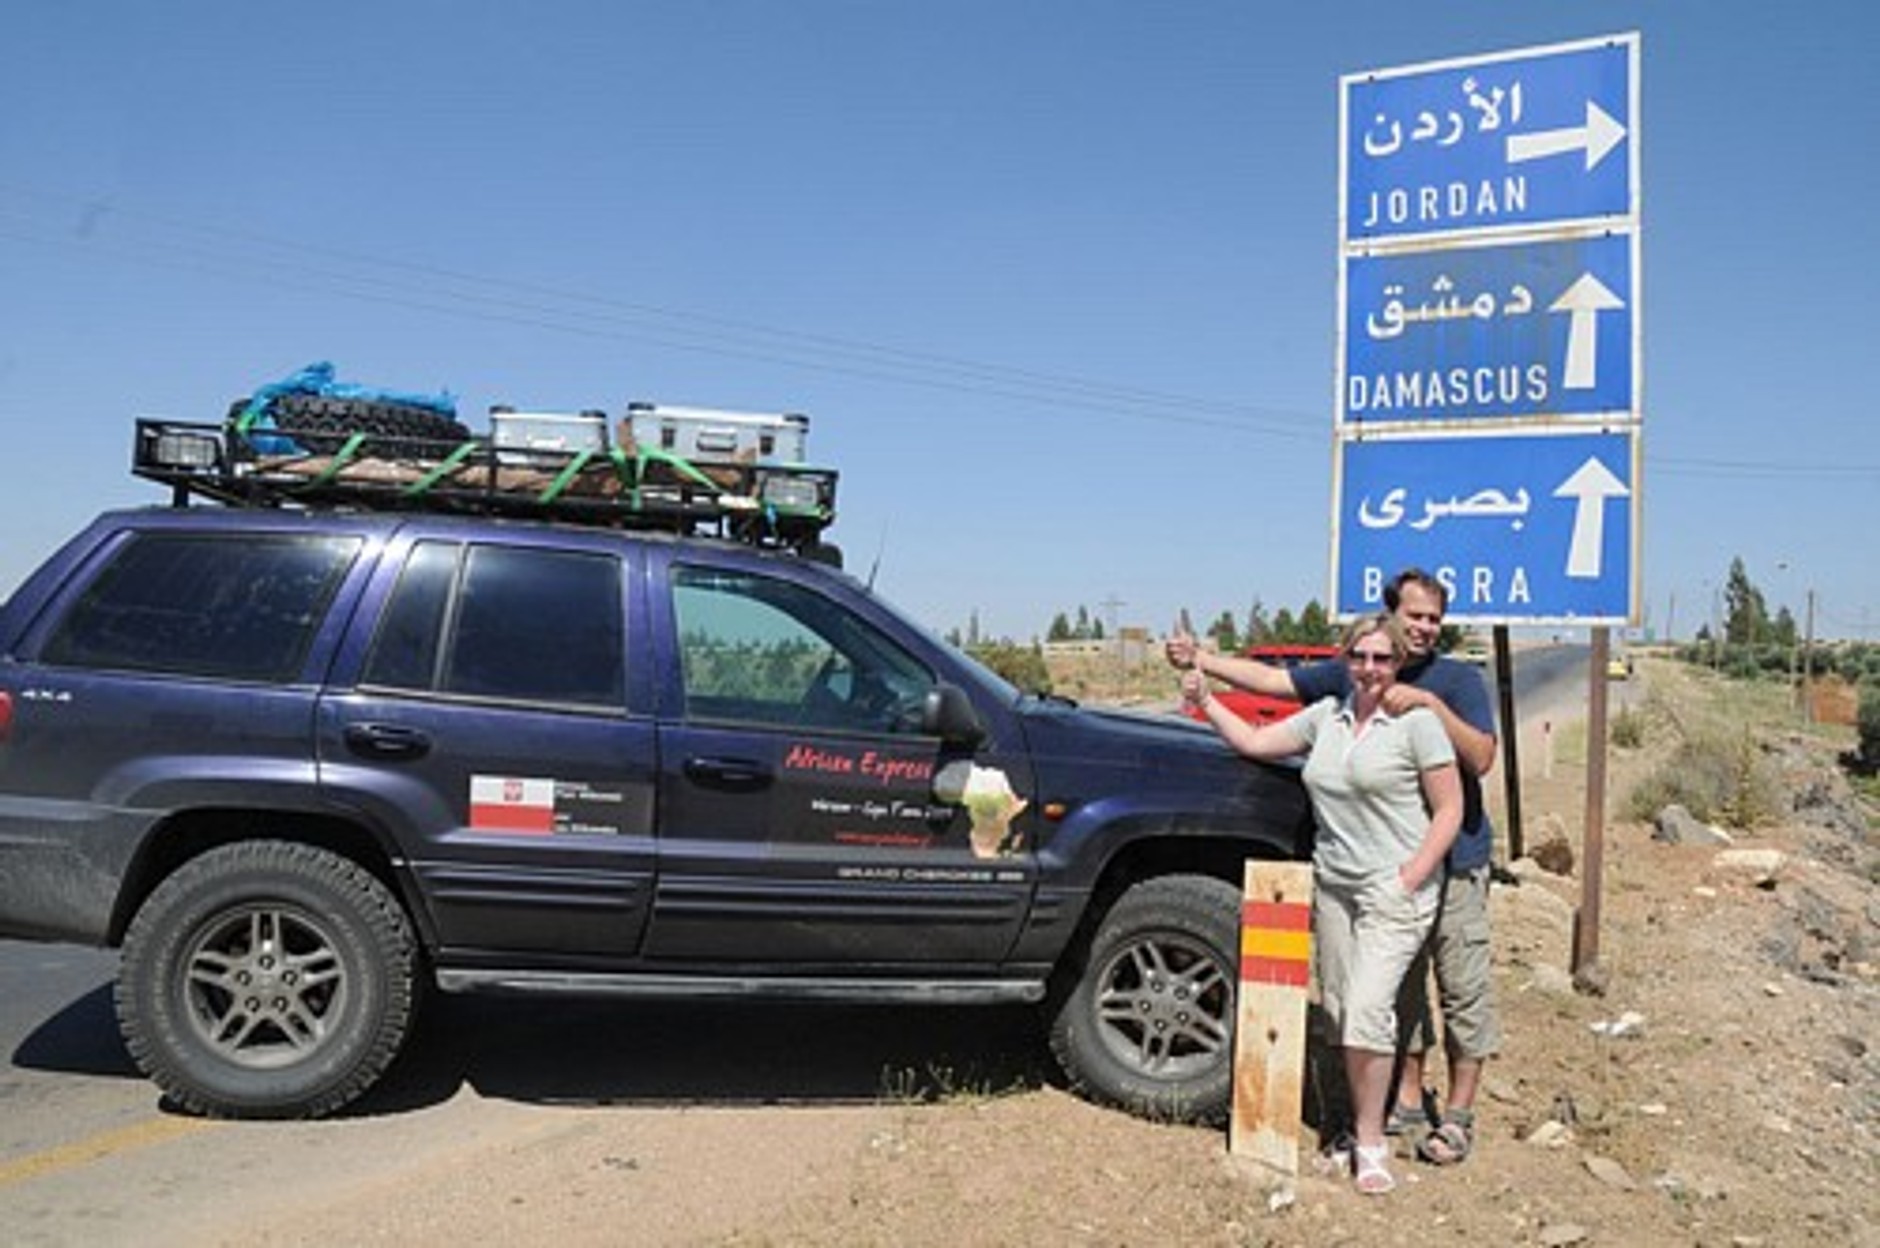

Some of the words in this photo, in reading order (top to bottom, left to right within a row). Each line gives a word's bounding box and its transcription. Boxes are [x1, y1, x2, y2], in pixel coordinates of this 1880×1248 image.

[1364, 77, 1521, 155] الأردن
[1365, 177, 1526, 226] JORDAN
[1368, 276, 1531, 338] دمشق
[1350, 365, 1547, 411] DAMASCUS
[1359, 487, 1531, 531] بصرى
[1364, 567, 1531, 603] BSRA
